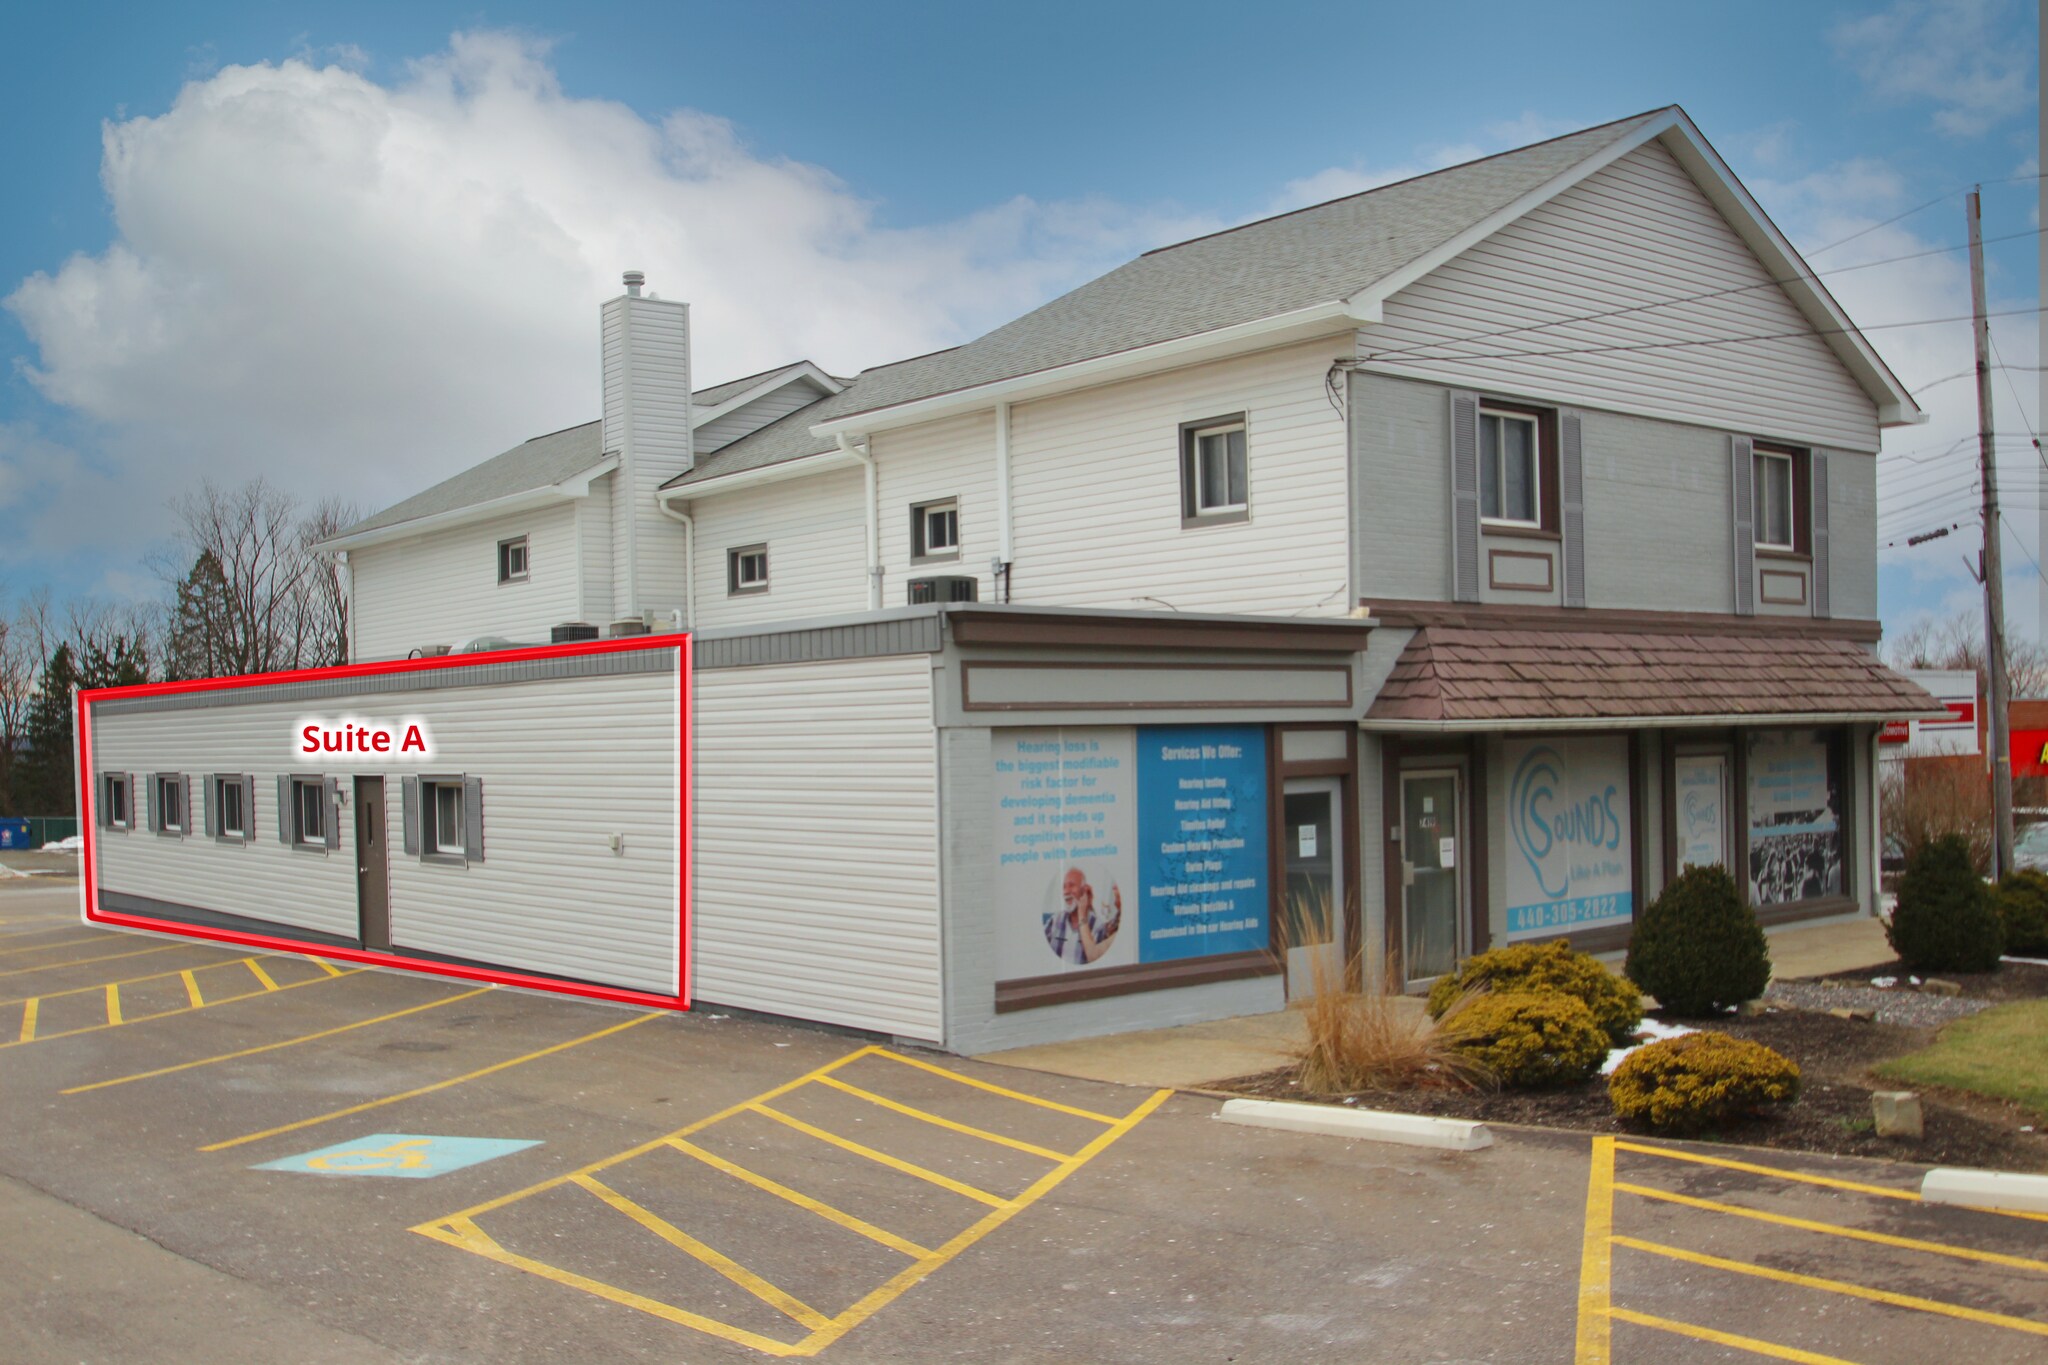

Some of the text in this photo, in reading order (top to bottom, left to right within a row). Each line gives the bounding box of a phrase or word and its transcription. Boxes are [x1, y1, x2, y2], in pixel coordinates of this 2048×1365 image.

[1017, 739, 1099, 755] Hearing loss is
[1161, 744, 1242, 760] Services We Offer:
[996, 756, 1120, 774] the biggest modifiable
[1021, 775, 1096, 789] risk factor for
[1179, 778, 1203, 789] Hearing
[1000, 792, 1116, 809] developing dementia
[1175, 800, 1200, 811] Hearing
[1201, 798, 1211, 809] Aid
[1014, 810, 1104, 826] and it speeds up
[1014, 827, 1104, 846] cognitive loss in
[1000, 844, 1117, 865] people with dementia
[1150, 886, 1176, 897] Hearing
